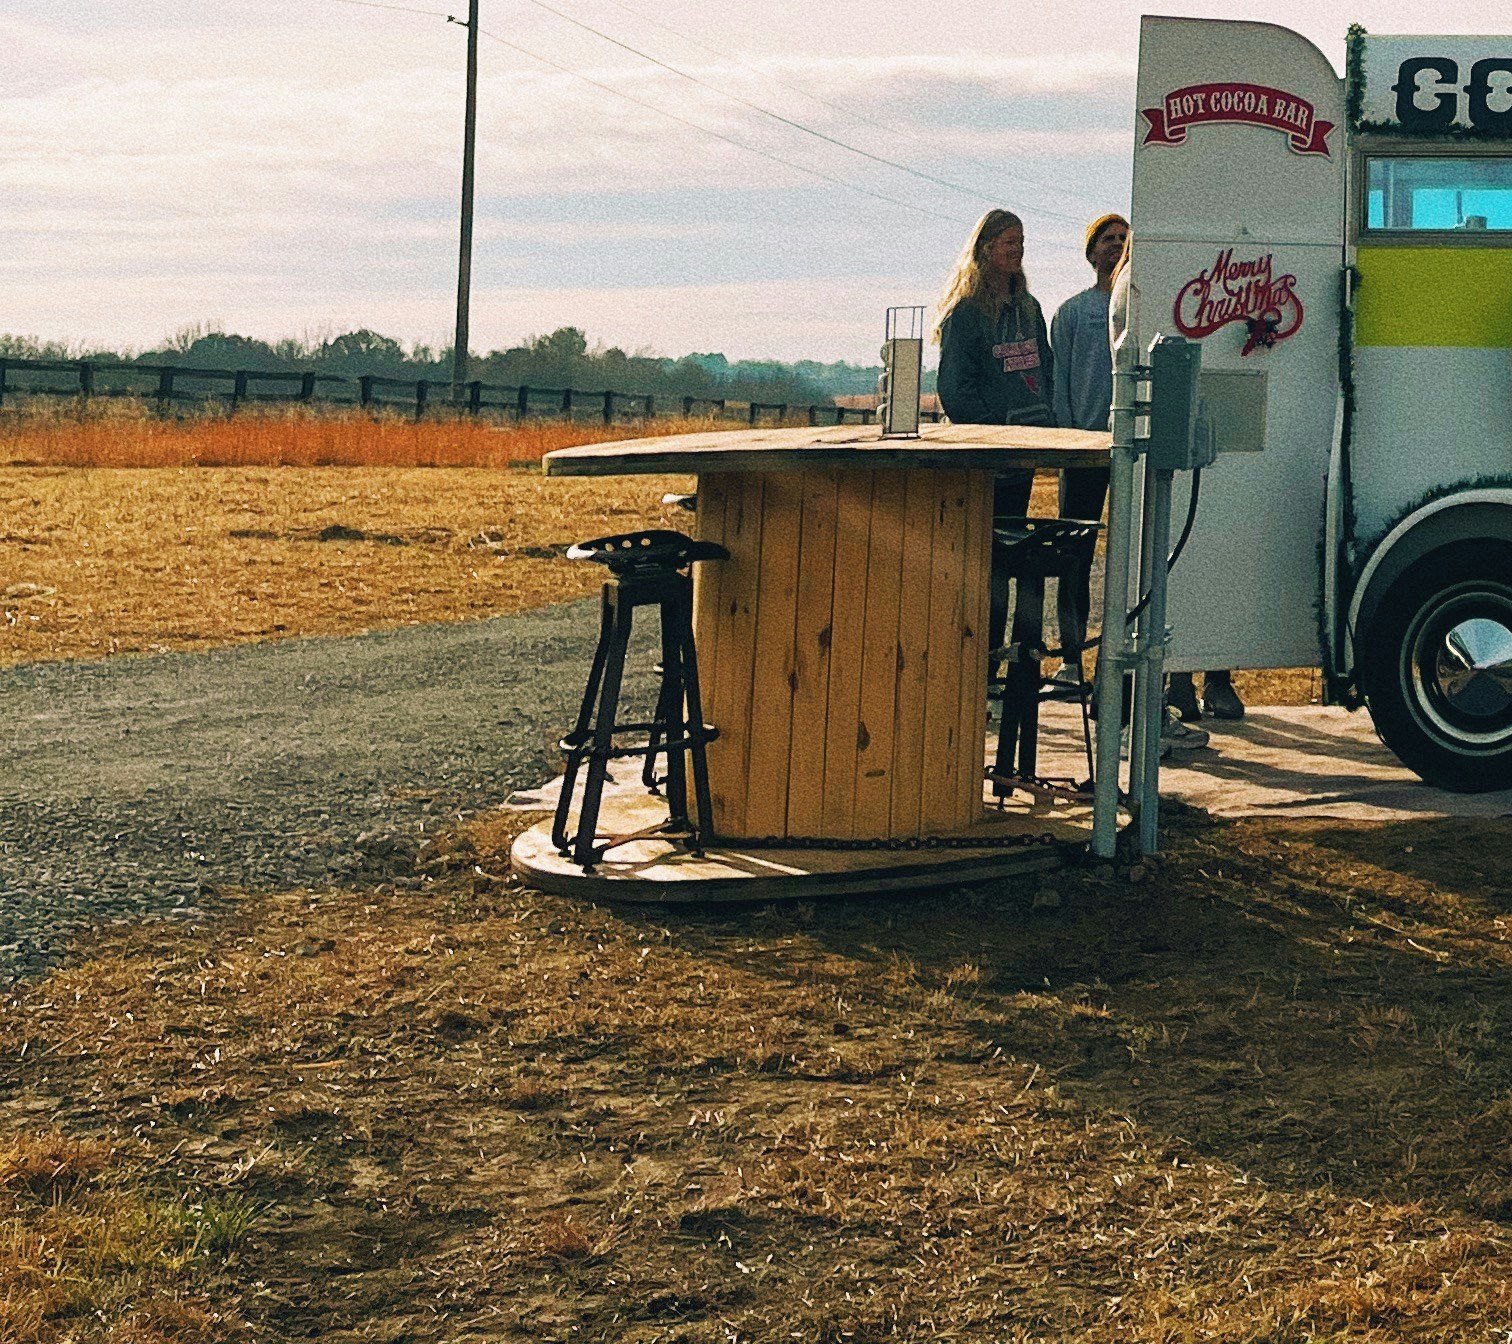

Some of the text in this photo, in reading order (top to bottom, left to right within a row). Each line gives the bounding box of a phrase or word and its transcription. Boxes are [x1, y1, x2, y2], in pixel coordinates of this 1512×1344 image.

[1169, 90, 1309, 130] HOT COCOA BAR
[1200, 248, 1273, 291] Merry
[1174, 274, 1304, 339] Christmas
